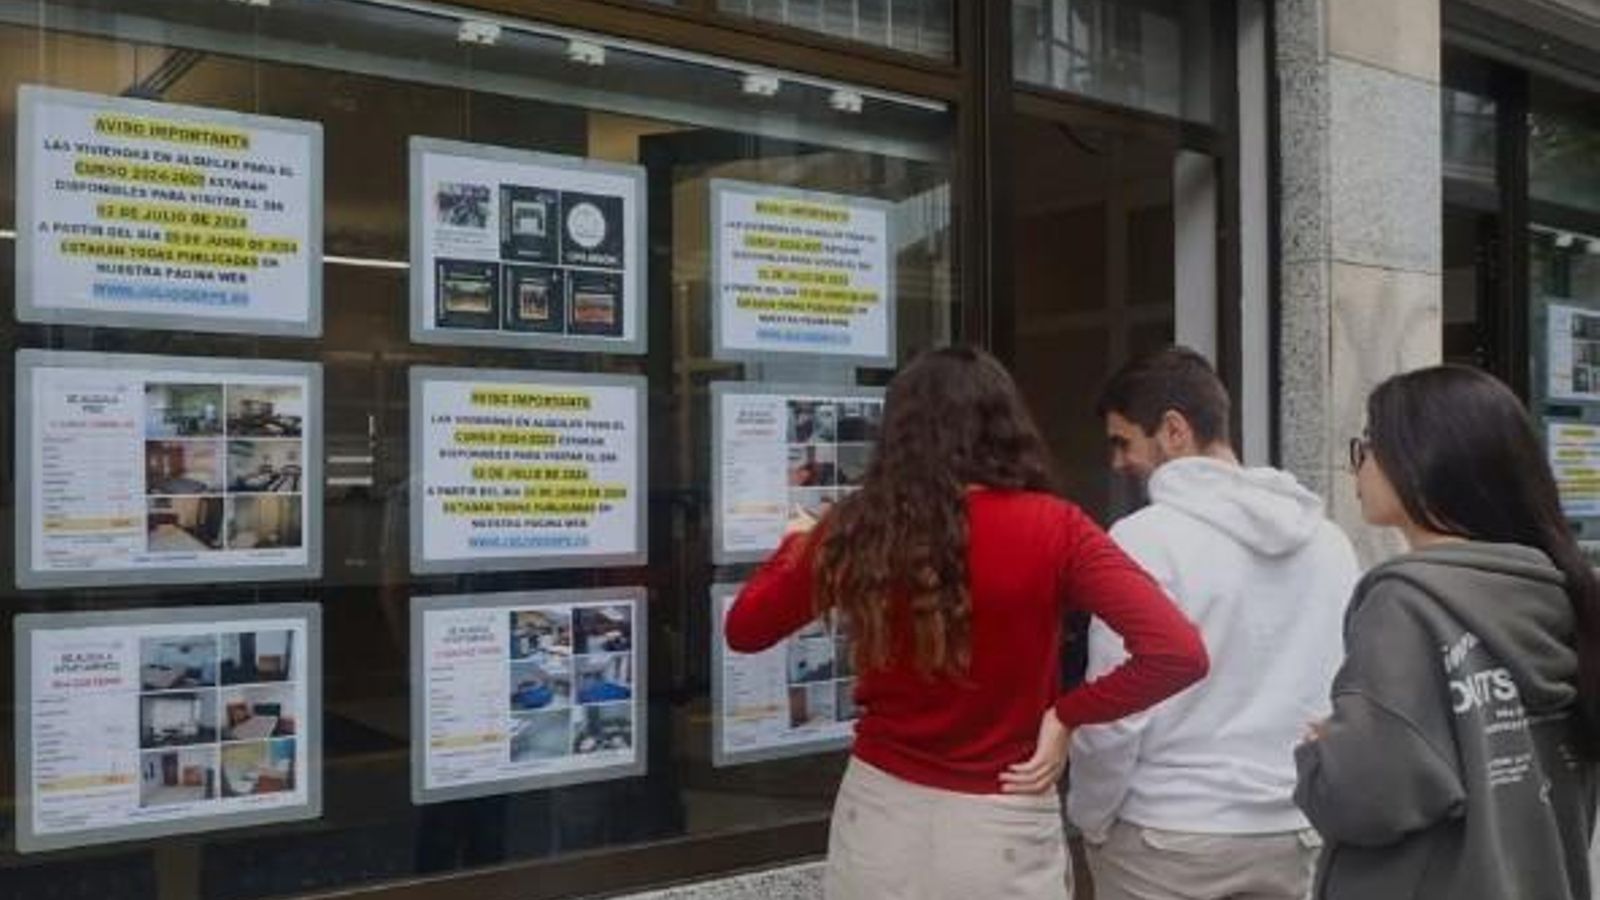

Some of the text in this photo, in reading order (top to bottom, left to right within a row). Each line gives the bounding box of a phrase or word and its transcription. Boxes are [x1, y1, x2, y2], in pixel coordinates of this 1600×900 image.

[95, 117, 249, 149] AVISO IMPORTANTE
[44, 139, 71, 152] LAS
[76, 142, 150, 161] VIVIENDAS
[153, 149, 170, 163] EN
[242, 160, 276, 175] PARA
[75, 161, 128, 178] CURSO
[151, 188, 185, 202] PARA
[120, 206, 137, 221] DE
[142, 208, 187, 225] JULIO
[191, 212, 209, 227] DE
[107, 225, 133, 239] DEL
[130, 246, 174, 262] TODAS
[177, 249, 258, 268] PUBLICADAS
[97, 263, 162, 278] NUESTRA
[218, 271, 246, 284] WEB
